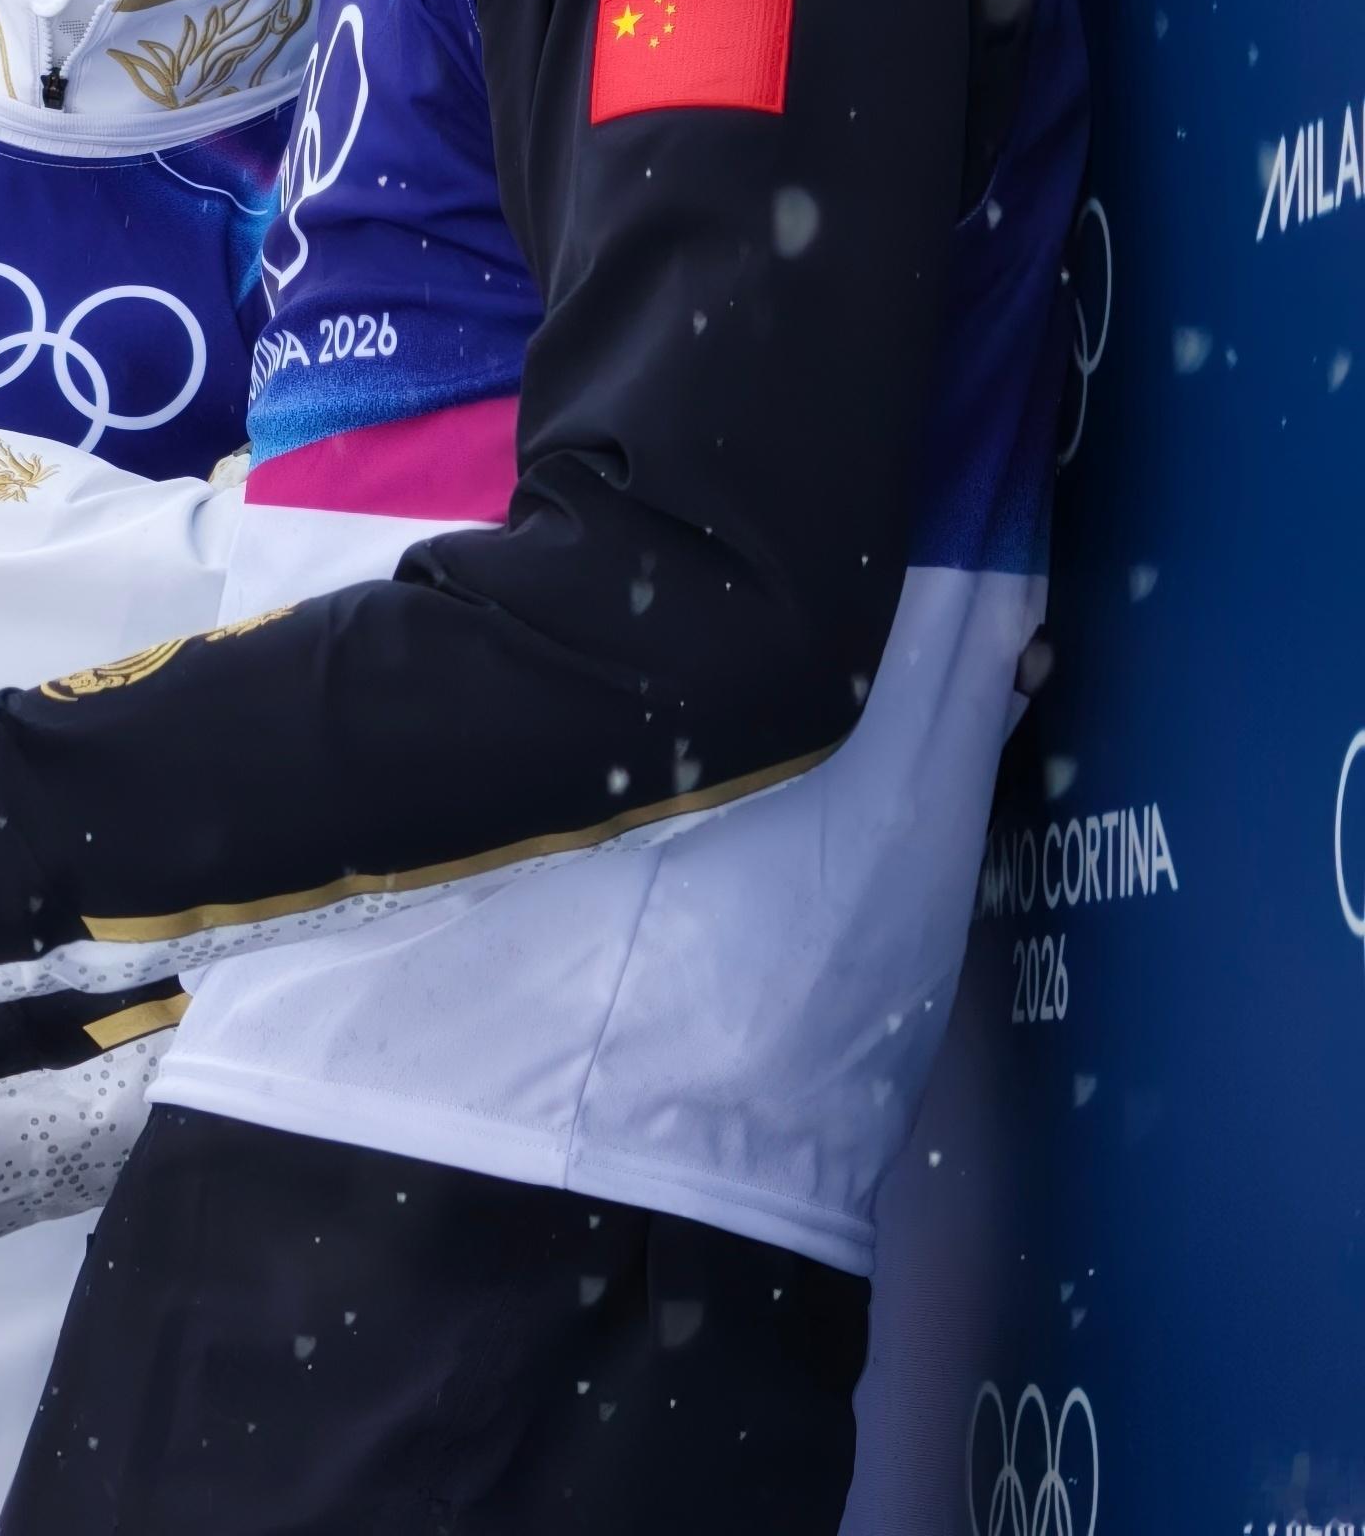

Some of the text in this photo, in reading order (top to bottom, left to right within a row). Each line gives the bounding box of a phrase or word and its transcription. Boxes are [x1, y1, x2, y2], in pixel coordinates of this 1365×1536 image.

[1255, 99, 1365, 244] MILA
[319, 311, 398, 364] 2026
[1042, 801, 1179, 910] CORTINA
[1011, 932, 1069, 1024] 2026
